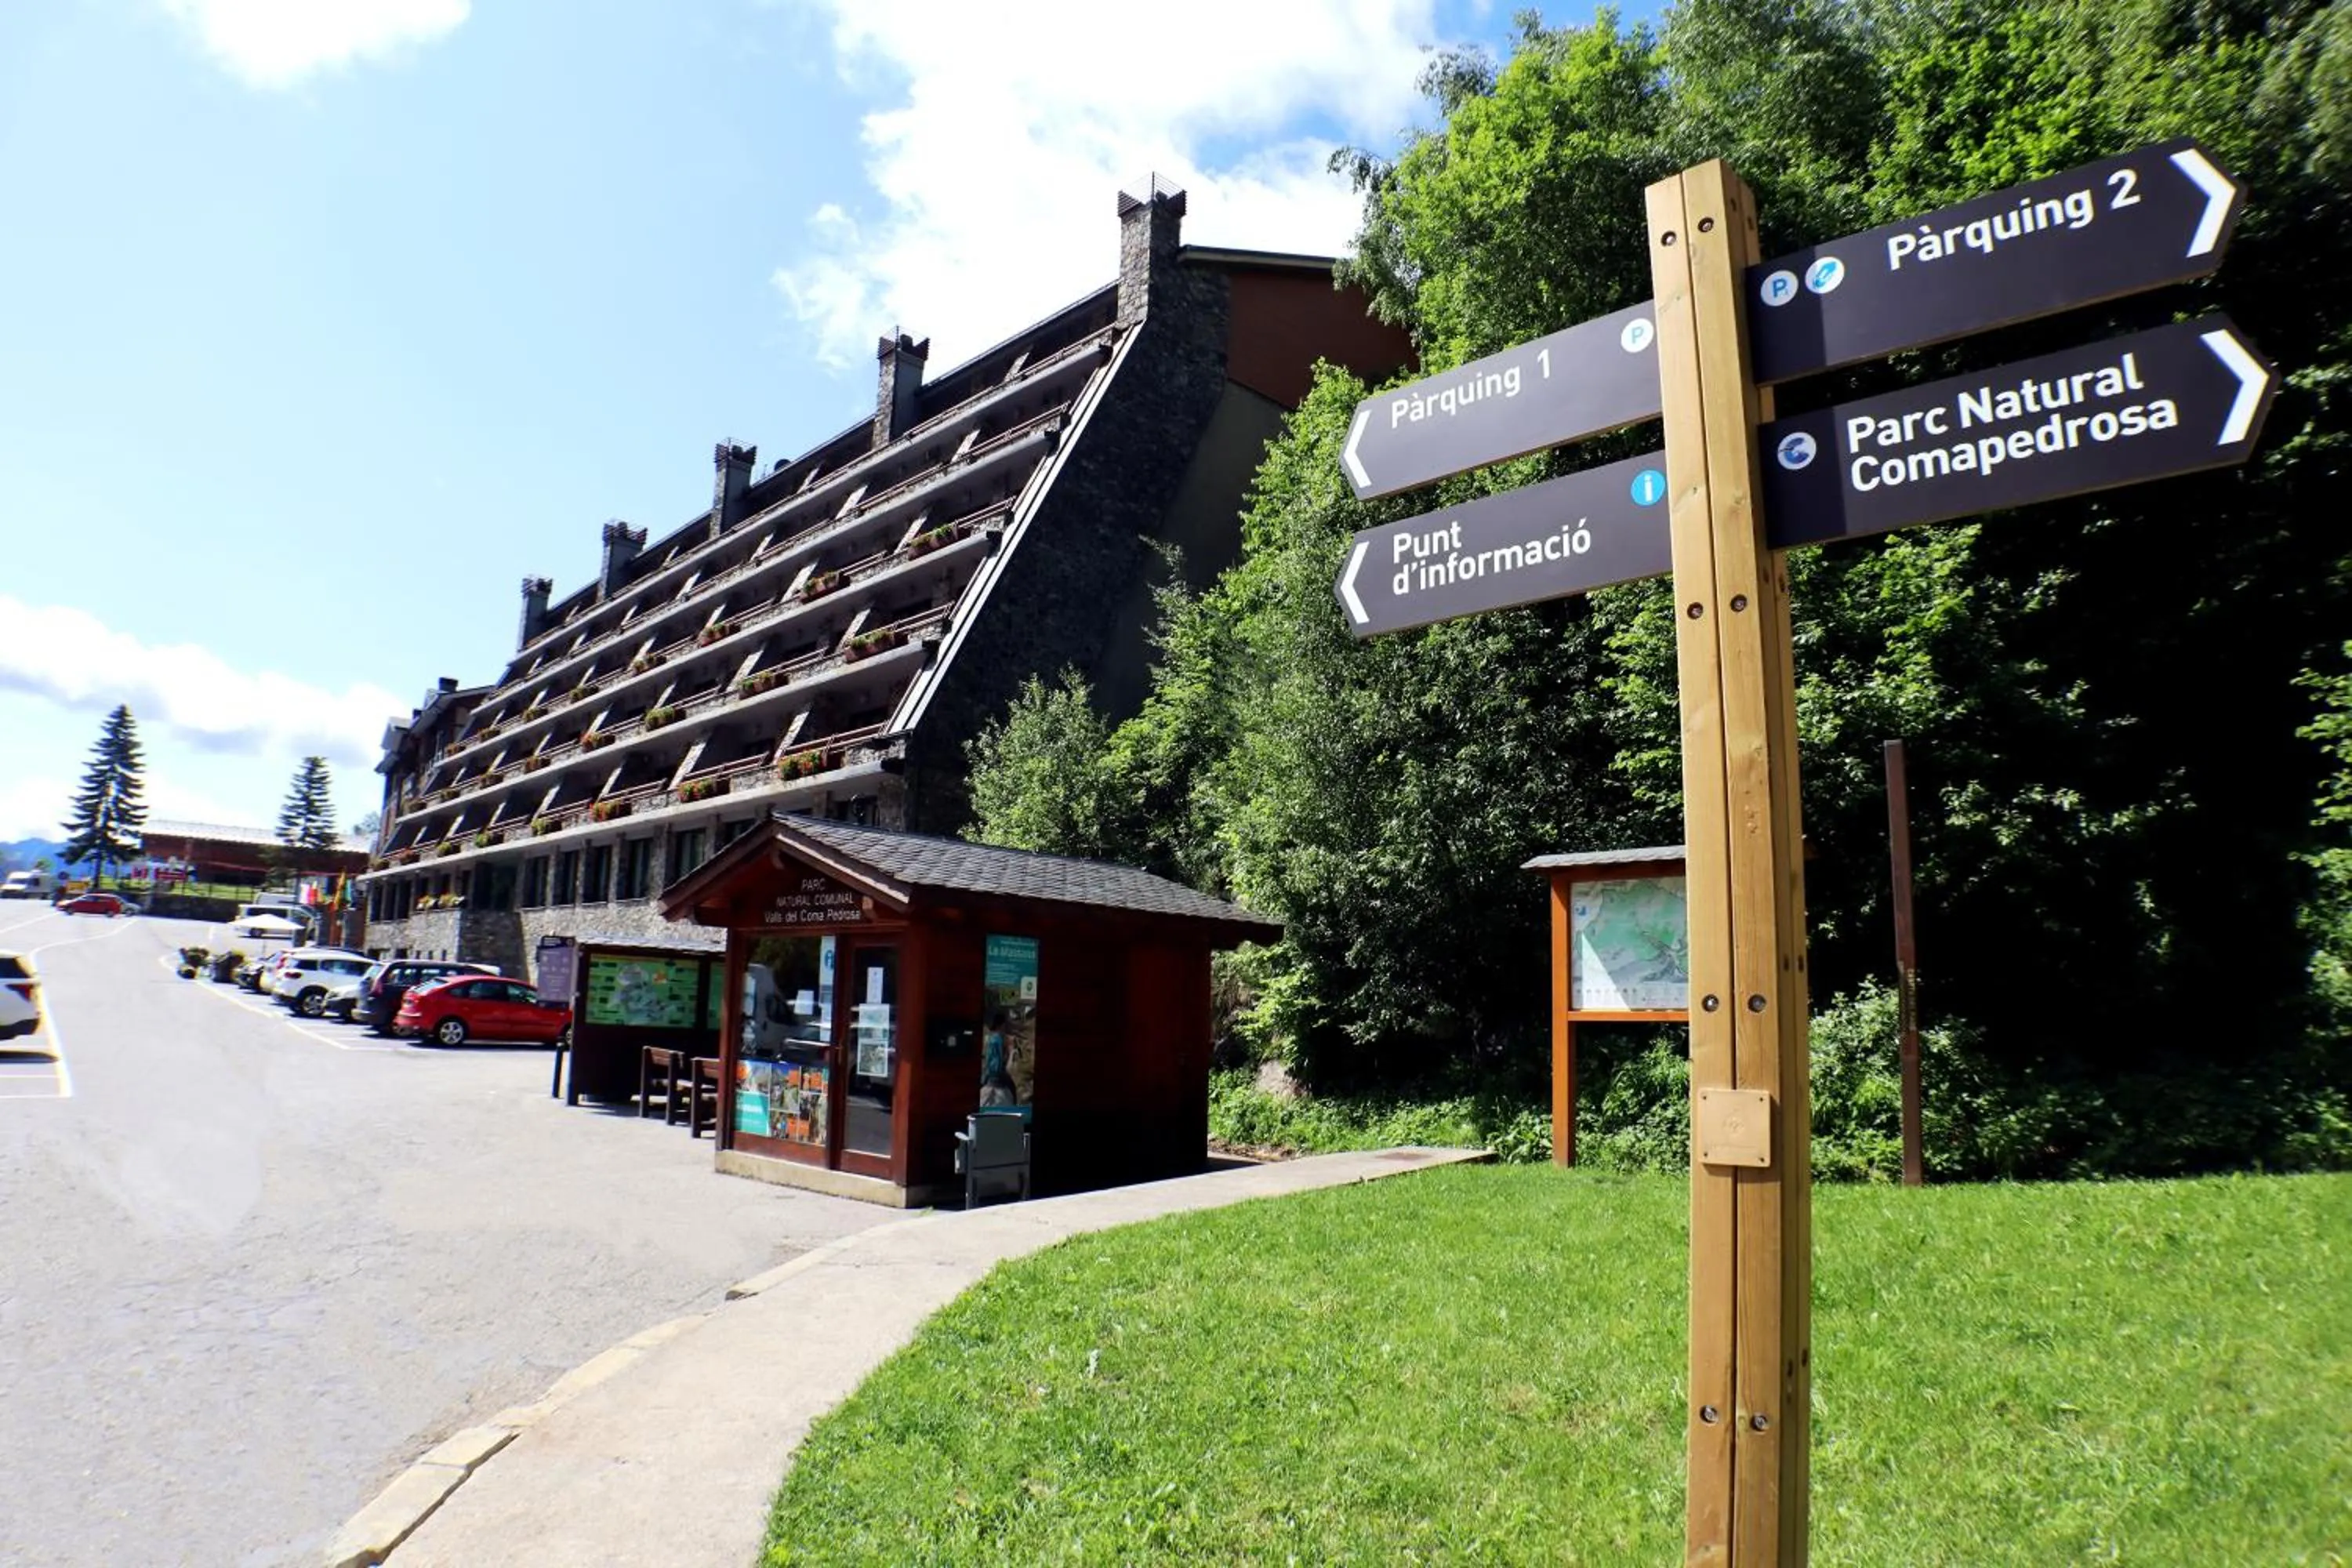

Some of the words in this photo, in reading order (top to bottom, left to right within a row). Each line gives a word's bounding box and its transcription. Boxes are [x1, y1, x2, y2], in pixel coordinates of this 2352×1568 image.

[1887, 189, 2094, 271] Pàrquing
[2108, 169, 2141, 210] 2
[1390, 363, 1523, 430] Pàrquing
[1535, 347, 1552, 380] 1
[1846, 405, 1949, 454] Parc
[1958, 352, 2144, 429] Natural
[1850, 398, 2178, 492] Comapedrosa
[1392, 520, 1463, 564] Punt
[1392, 516, 1592, 596] d'informació
[776, 895, 811, 907] NATURAL
[815, 892, 855, 905] COMUNAL
[785, 910, 797, 922] del
[800, 909, 824, 921] Coma
[827, 909, 861, 921] Pedrosa
[801, 878, 826, 891] PARC
